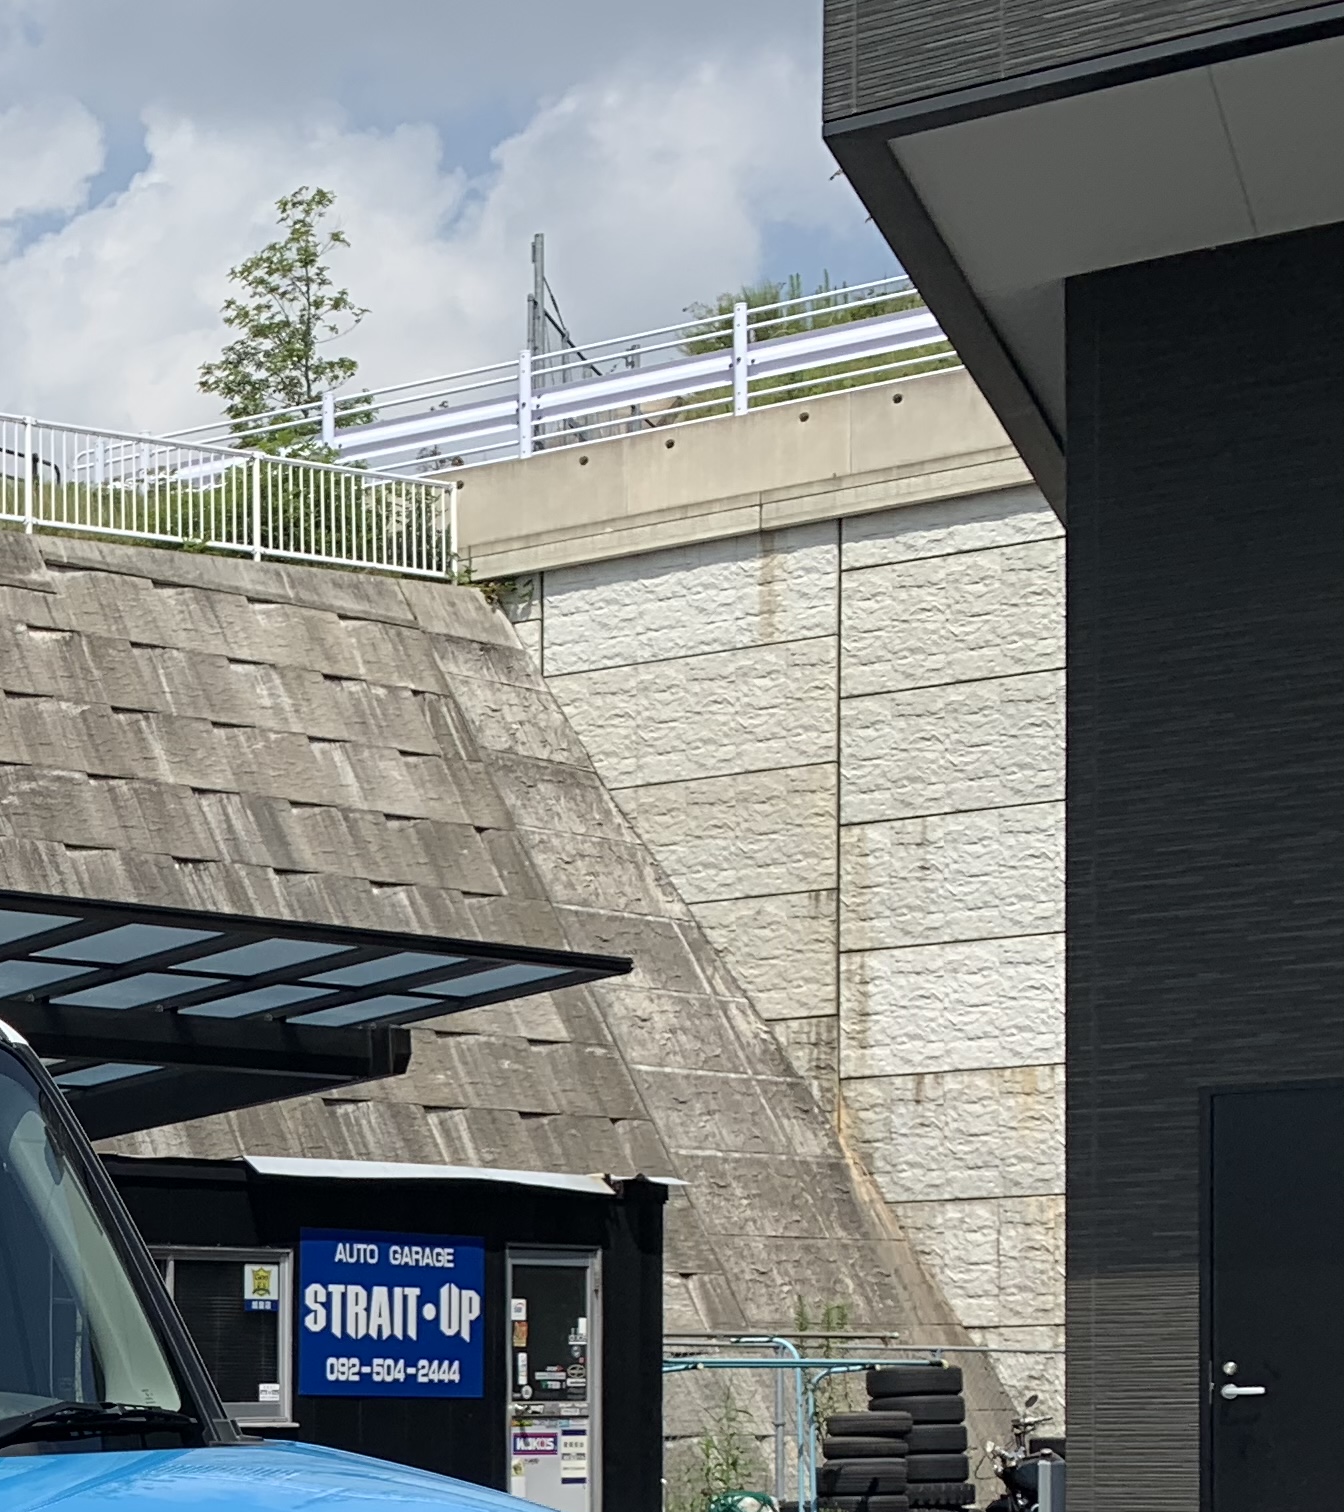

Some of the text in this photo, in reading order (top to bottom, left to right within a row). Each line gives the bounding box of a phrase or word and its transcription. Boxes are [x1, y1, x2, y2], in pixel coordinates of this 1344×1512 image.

[334, 1243, 455, 1268] AUTO GARAGE
[325, 1357, 461, 1384] 092-504-2444
